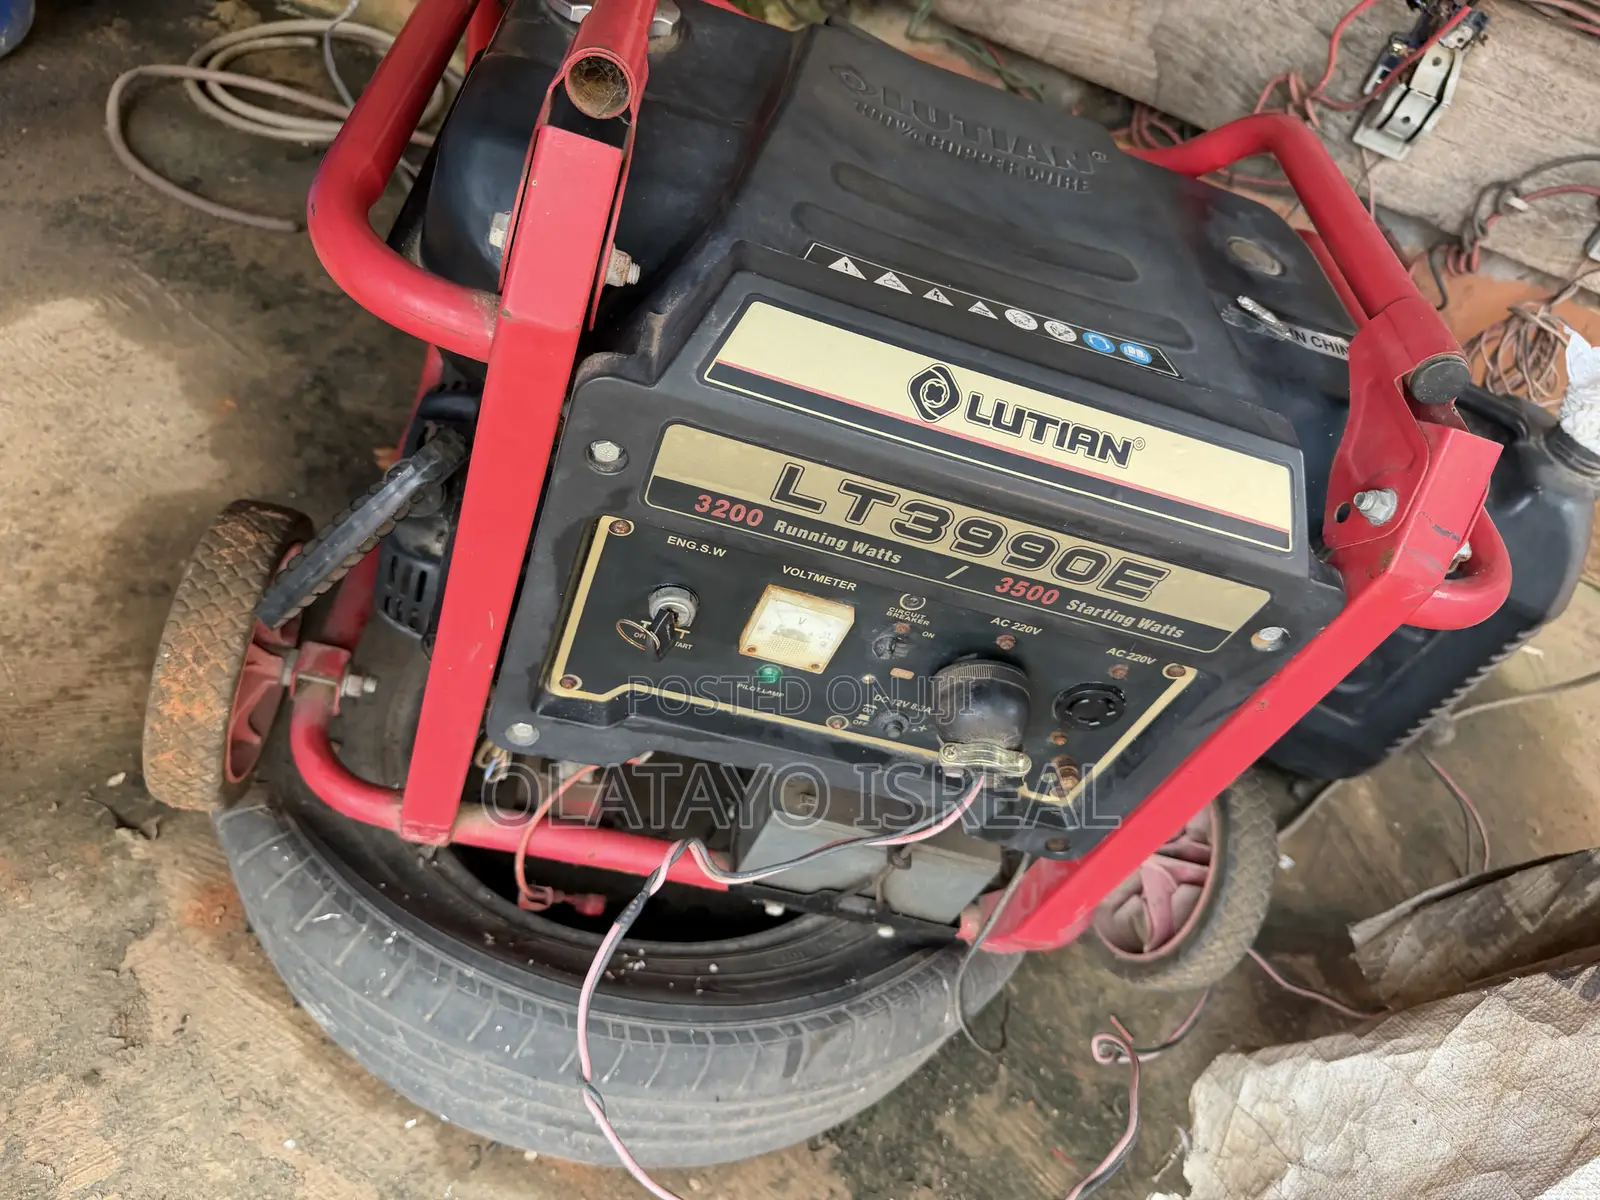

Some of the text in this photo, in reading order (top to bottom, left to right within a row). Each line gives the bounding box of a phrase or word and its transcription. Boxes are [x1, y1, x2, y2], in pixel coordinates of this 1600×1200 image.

[1021, 164, 1093, 193] WIRE
[1311, 335, 1349, 356] CHIN
[770, 462, 1171, 602] LT3990E
[667, 535, 728, 558] ENG.S.W
[694, 494, 764, 527] 3200
[773, 519, 848, 551] Running
[852, 541, 902, 564] Watts
[995, 576, 1060, 606] 3500
[1066, 599, 1136, 628] Starting
[1137, 617, 1185, 639] Watts
[782, 565, 858, 592] VOLTMETER
[885, 610, 931, 626] BREAKER
[888, 606, 927, 620] CIRCUIT
[921, 631, 936, 639] ON
[990, 616, 1044, 636] AC 220V
[1106, 647, 1158, 666] AC 220V
